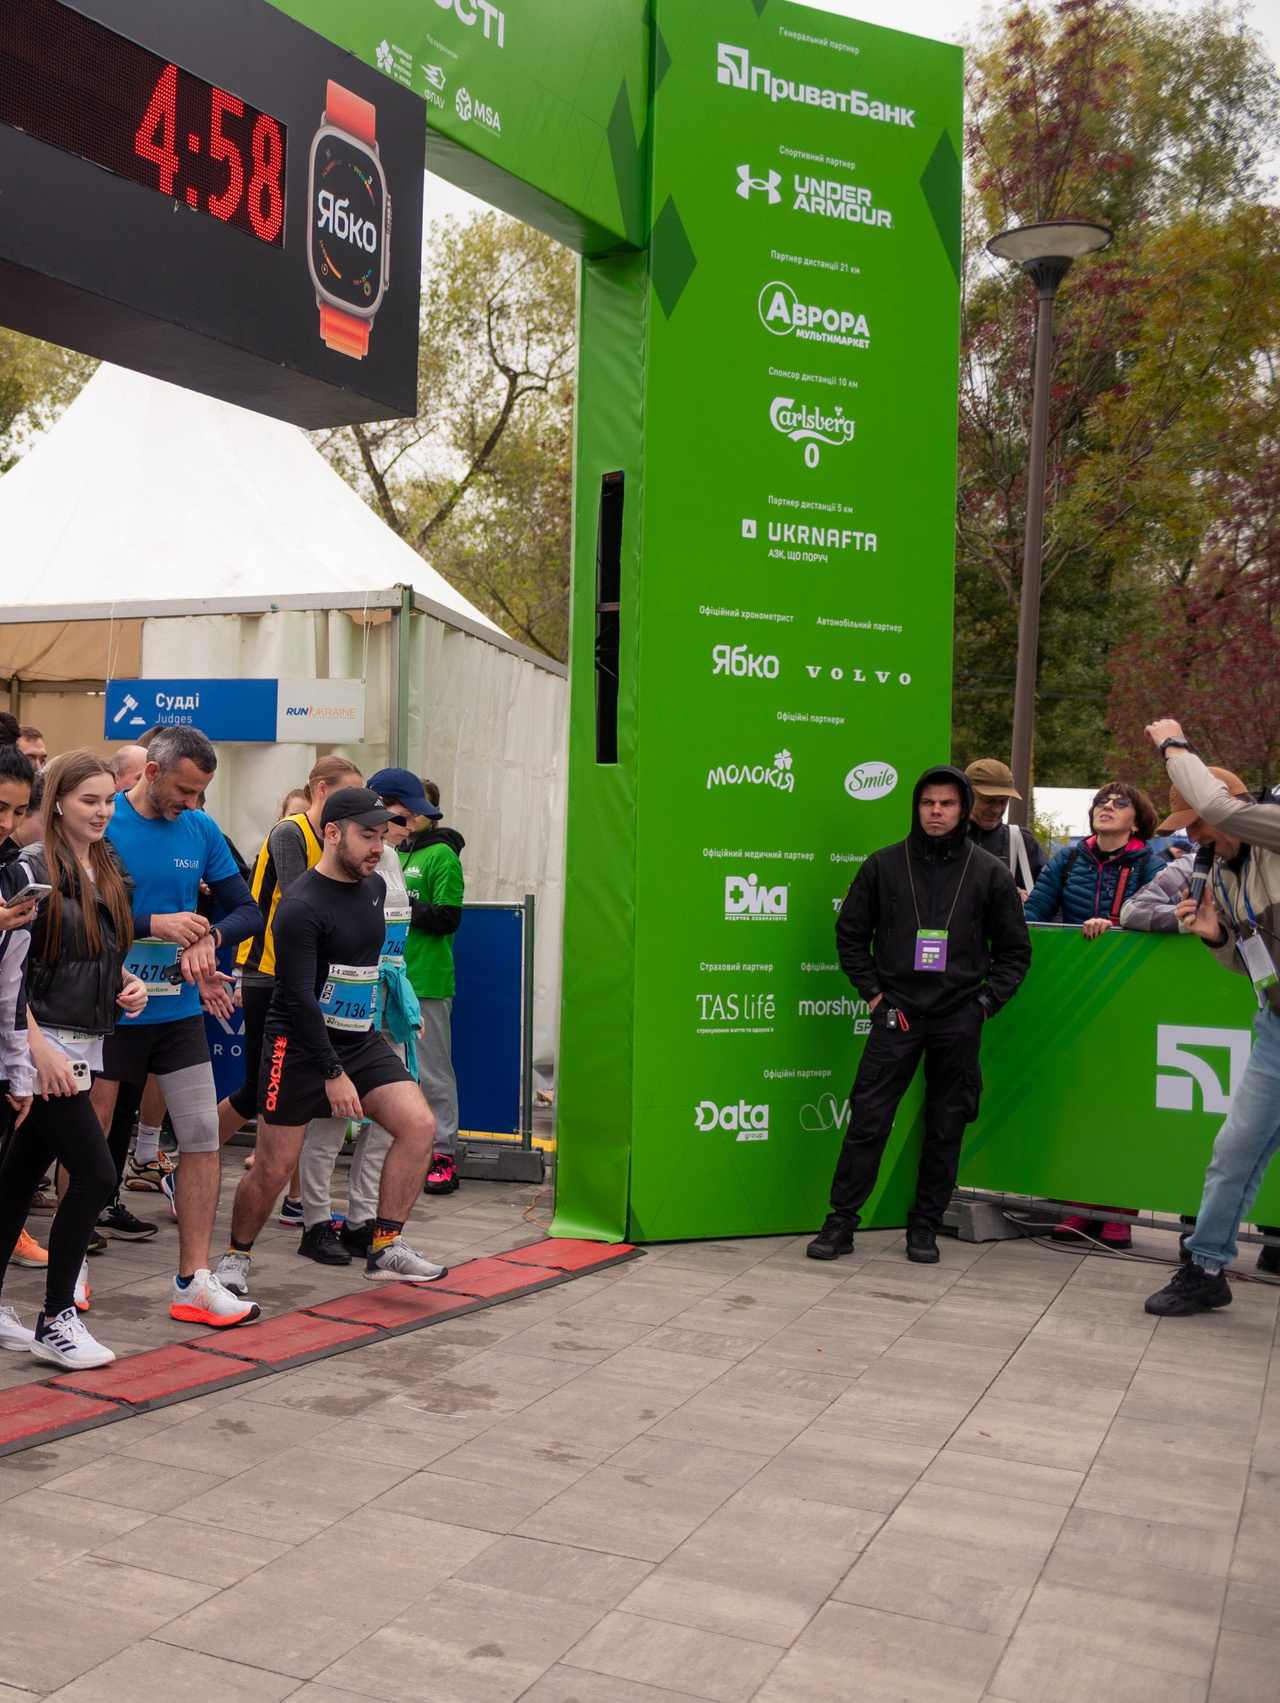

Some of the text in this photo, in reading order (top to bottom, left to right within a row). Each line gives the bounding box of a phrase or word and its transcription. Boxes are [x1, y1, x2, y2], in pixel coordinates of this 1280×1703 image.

[434, 0, 505, 48] СТІ
[779, 26, 860, 55] Генеральний партнер
[423, 89, 446, 110] ФЛАУ
[750, 66, 915, 128] ПриватБанк
[474, 99, 501, 132] MSA
[134, 63, 282, 241] 4:58
[779, 145, 856, 171] Спортивний партнер
[794, 174, 872, 206] UNDER
[317, 189, 377, 253] Ябко
[793, 193, 893, 229] ARMOUR
[771, 250, 860, 274] Партнер дистанції 21 км
[796, 329, 870, 349] МУЛЬТИМАРКЕТ
[768, 366, 858, 388] Спонсор дистанції 10 км
[769, 397, 855, 444] Carlsberg
[768, 495, 853, 513] Партнер дистанції 5 км
[768, 521, 877, 552] UKRNAFTA
[768, 548, 828, 563] АЗК, ЩО ПОРУЧ
[699, 605, 794, 623] Офіційний хронометрист
[816, 616, 902, 633] Автомобільний партнер
[712, 644, 779, 678] Ябко
[806, 665, 911, 685] VOLVO
[155, 693, 200, 710] Судді
[286, 707, 357, 717] RUN UKRAINE
[155, 713, 193, 725] Judges
[777, 711, 845, 725] Офіційні партнери
[848, 767, 894, 791] Smile
[173, 858, 189, 868] TAS
[703, 847, 814, 860] Офіційний медичний партнер
[699, 962, 774, 971] Страховий партнер
[801, 963, 839, 971] Офіційний
[332, 1000, 366, 1018] 7136
[696, 994, 740, 1020] TAS
[798, 996, 872, 1019] morshyn
[764, 1069, 832, 1079] Офіційні партнери
[694, 1100, 769, 1131] Data
[744, 1132, 764, 1140] group
